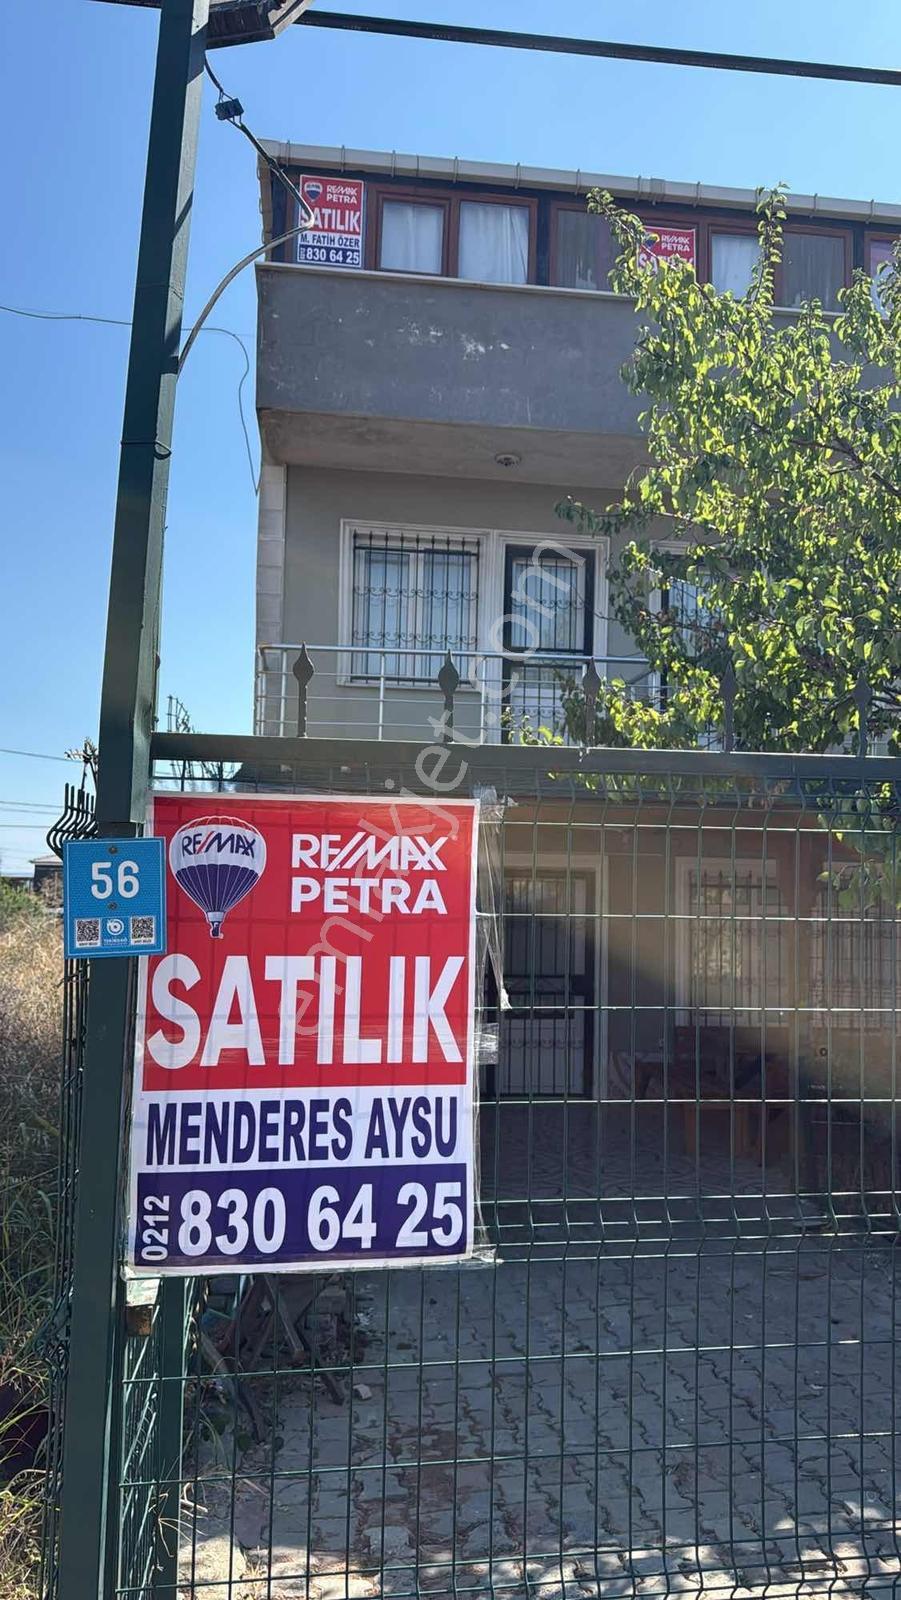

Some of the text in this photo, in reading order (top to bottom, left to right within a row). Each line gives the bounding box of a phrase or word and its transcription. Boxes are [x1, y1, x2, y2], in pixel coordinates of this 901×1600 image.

[326, 185, 358, 196] RE/MAX
[326, 194, 357, 204] PETRA
[300, 233, 309, 243] M.
[661, 242, 690, 252] PETRA
[306, 247, 326, 261] 830
[329, 249, 343, 263] 64
[345, 251, 360, 264] 25
[181, 831, 256, 859] RE/MAX
[291, 832, 448, 872] RE/MAX
[91, 860, 140, 899] 56
[291, 877, 448, 914] PETRA
[146, 953, 466, 1069] SATILIK
[146, 1096, 457, 1165] MENDERES AYSU
[141, 1182, 463, 1261] 0212 830 64 25
